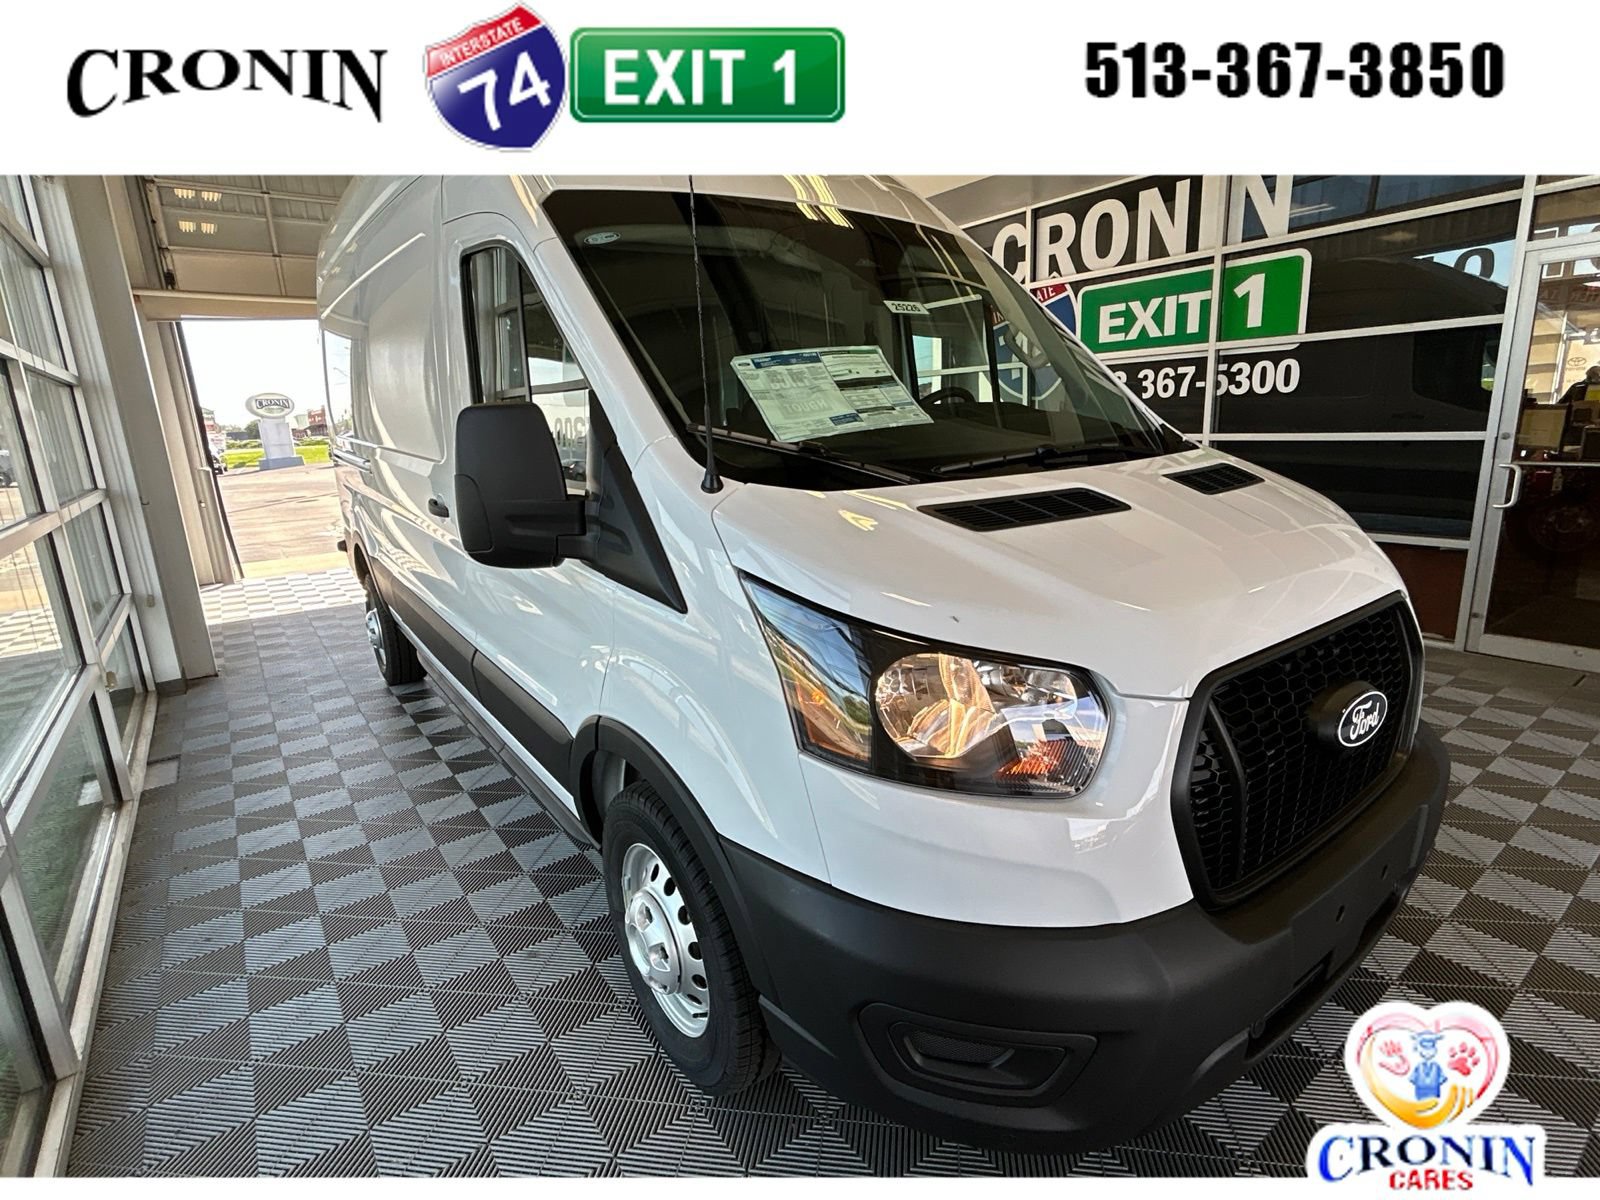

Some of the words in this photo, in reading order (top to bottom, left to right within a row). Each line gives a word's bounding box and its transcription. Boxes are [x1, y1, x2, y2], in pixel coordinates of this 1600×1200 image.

[992, 175, 1293, 283] CRONIN
[1098, 290, 1212, 344] EXIT
[1233, 273, 1266, 329] 1
[1137, 358, 1301, 399] 367-5300
[256, 399, 290, 410] CRONIN
[1350, 700, 1379, 740] Ford
